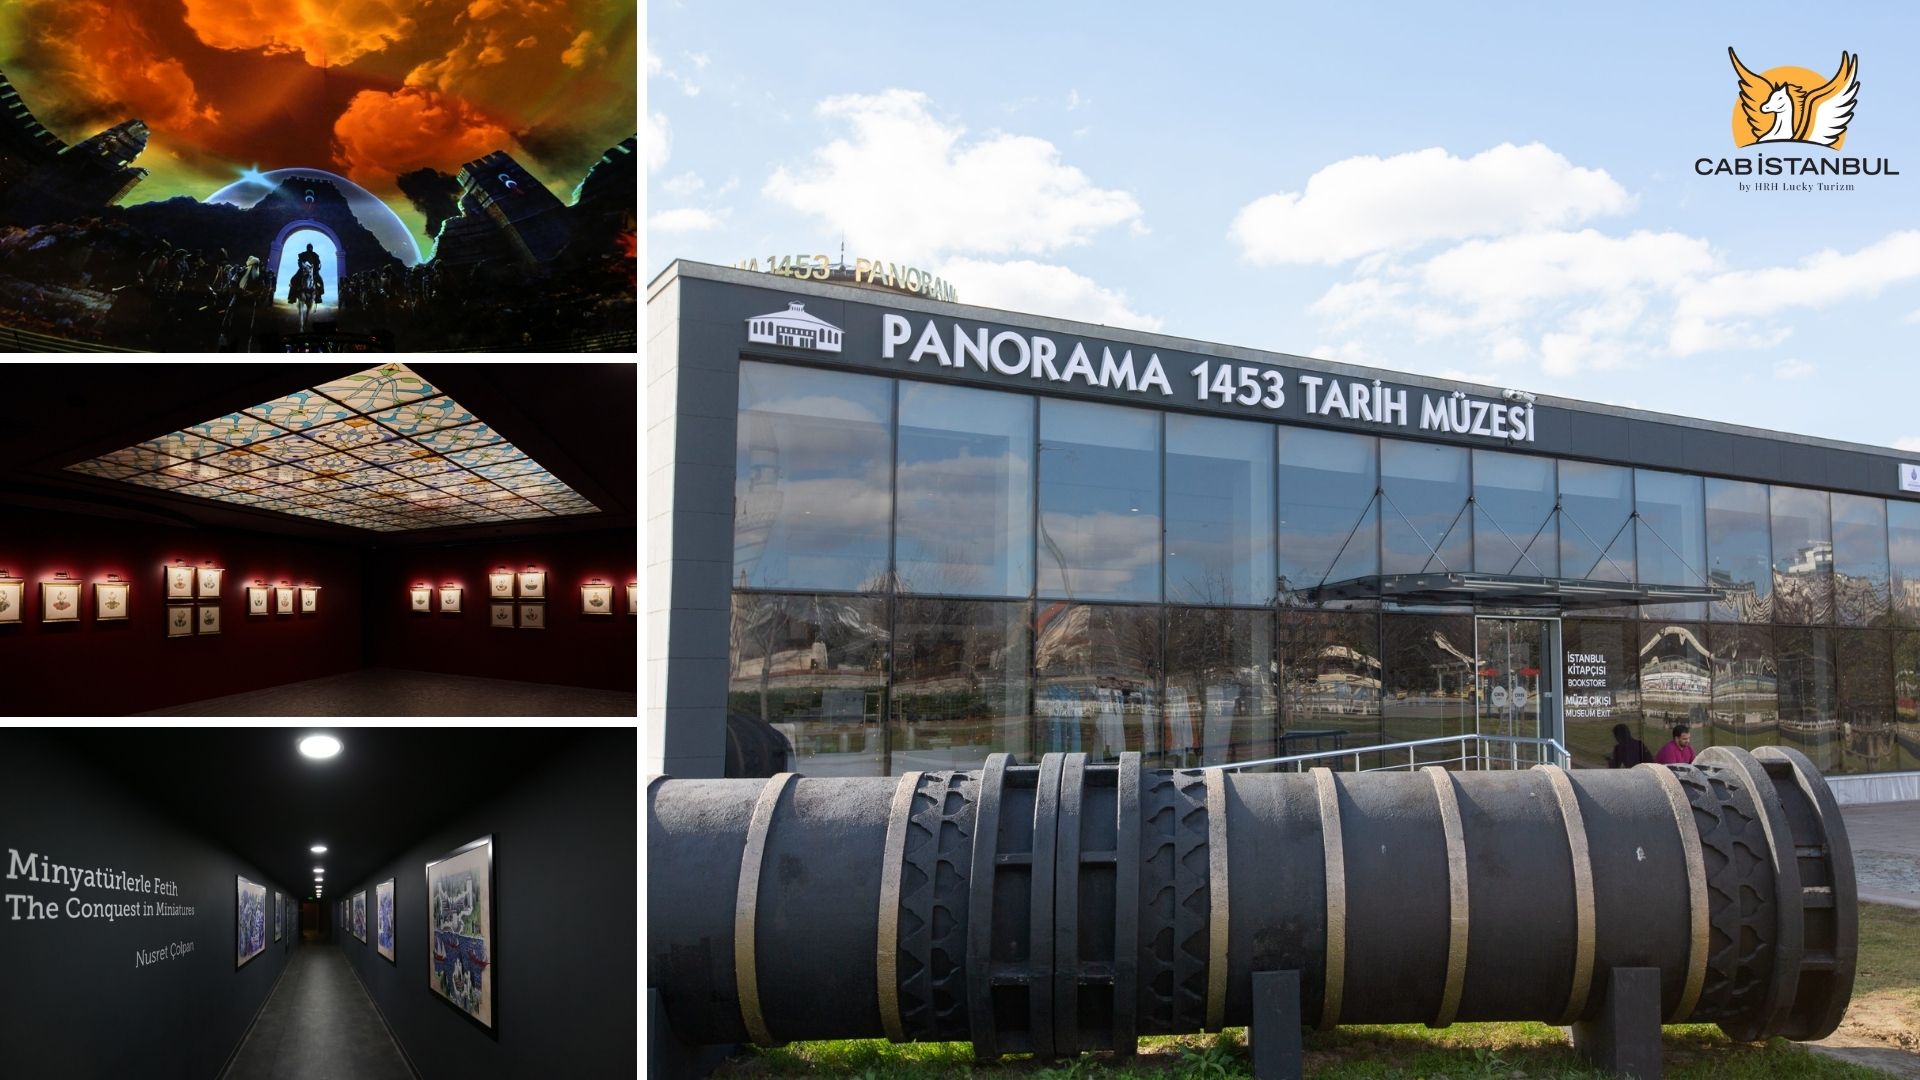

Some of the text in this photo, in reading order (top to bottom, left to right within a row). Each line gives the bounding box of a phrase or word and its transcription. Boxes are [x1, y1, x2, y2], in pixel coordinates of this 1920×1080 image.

[766, 254, 830, 280] 1453
[881, 313, 1535, 442] PANORAMA 1453 TARİH MÜZESİ
[1567, 651, 1606, 663] İSTANBUL
[1567, 663, 1606, 676] KİTAPÇISI
[1565, 693, 1588, 705] MÜZE
[1565, 709, 1611, 717] MUSEUM EXIT
[6, 848, 178, 897] Minyatürlerle Fetih
[5, 894, 195, 921] The Conquest in Miniatures
[136, 941, 194, 968] Nusret Çolpan
